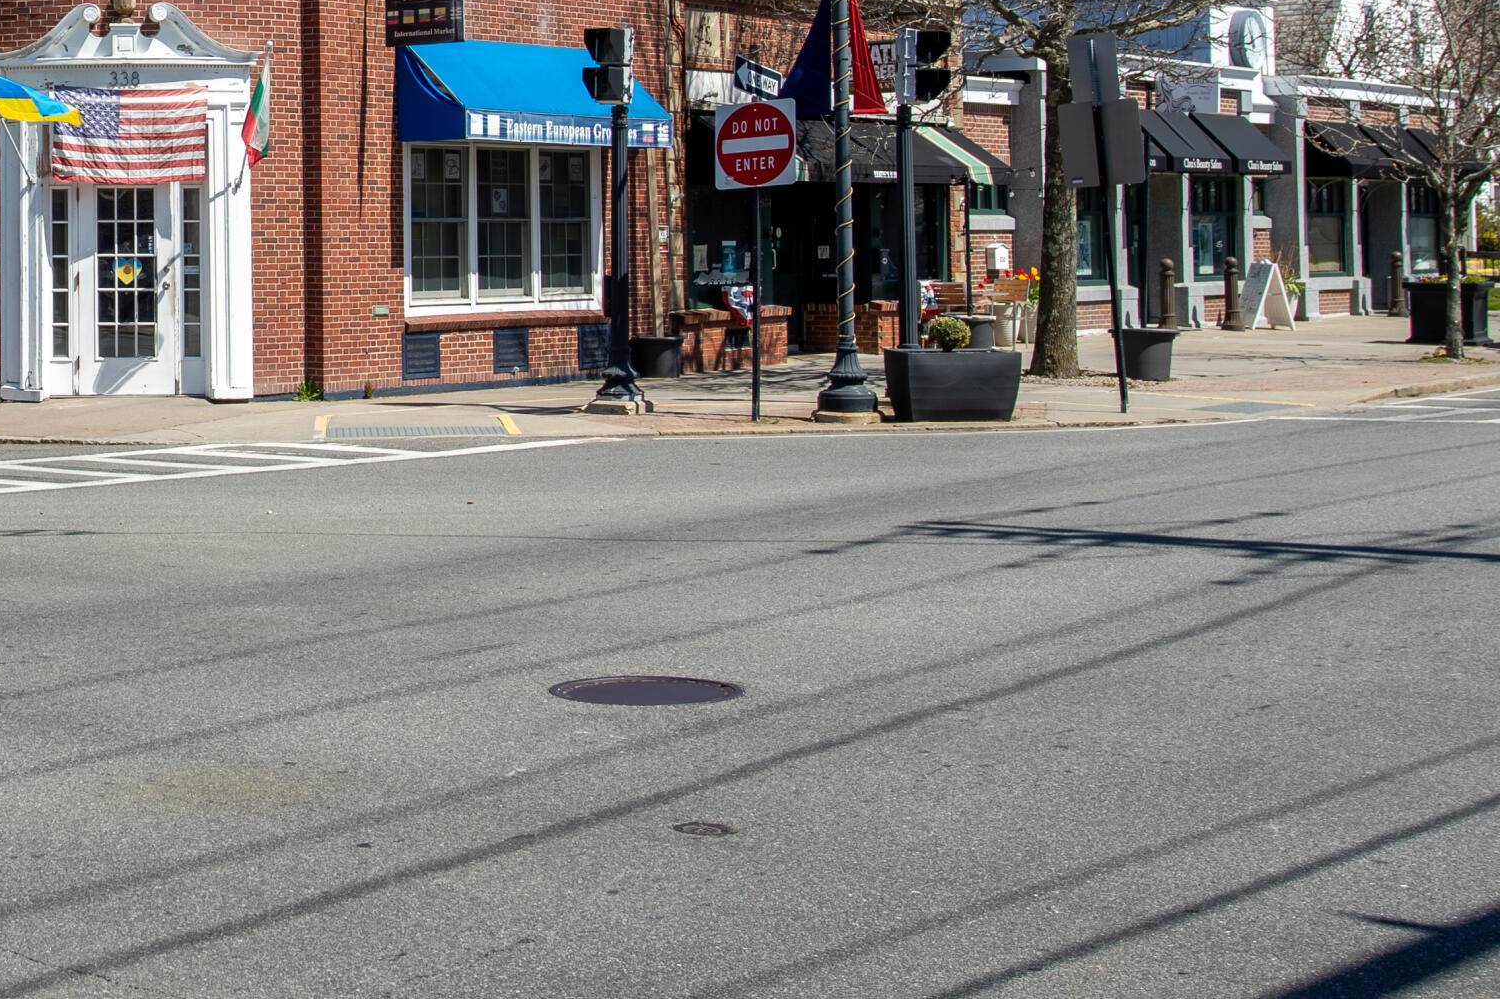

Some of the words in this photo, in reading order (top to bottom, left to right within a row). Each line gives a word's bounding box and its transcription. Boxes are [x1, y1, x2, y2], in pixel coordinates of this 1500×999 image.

[394, 28, 433, 38] International
[109, 71, 140, 87] 338
[747, 70, 761, 88] ONE
[762, 77, 777, 93] WAY
[506, 118, 543, 136] Eastern
[546, 120, 591, 140] European
[593, 123, 638, 139] Groes
[732, 120, 748, 135] DO
[755, 117, 779, 132] NOT
[735, 156, 775, 172] ENTER
